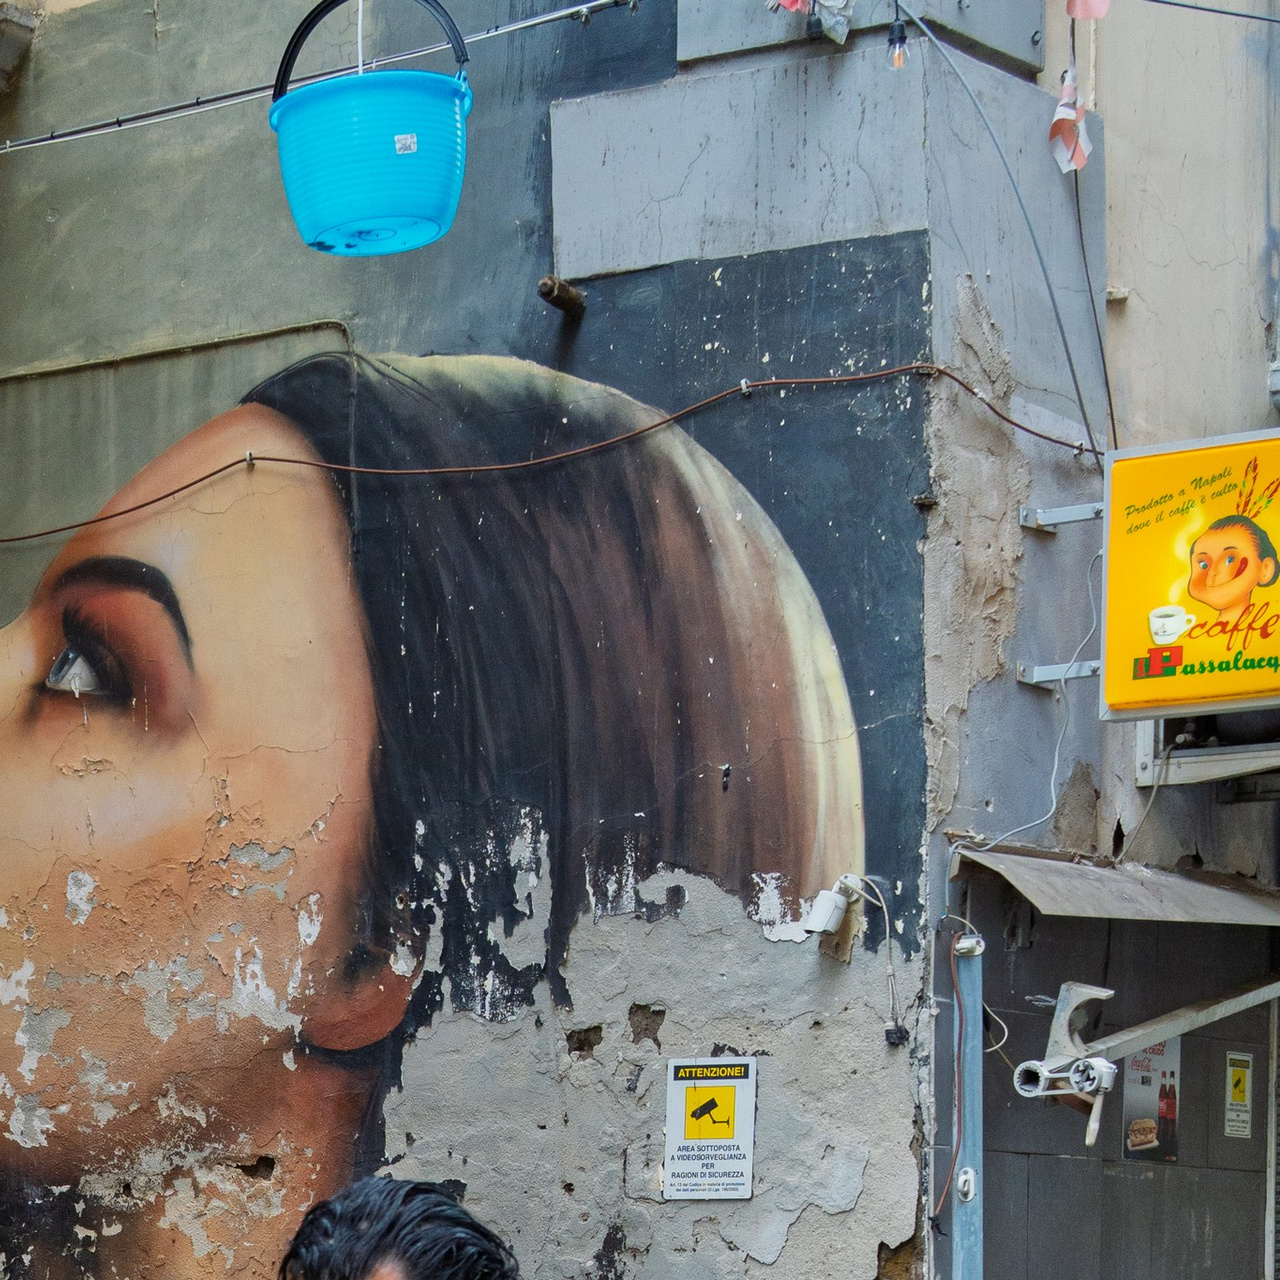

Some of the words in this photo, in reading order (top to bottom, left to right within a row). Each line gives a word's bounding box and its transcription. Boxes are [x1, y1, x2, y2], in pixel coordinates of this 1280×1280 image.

[1124, 492, 1175, 519] Prodotto
[1178, 488, 1186, 497] a
[1190, 466, 1233, 491] Napoli
[1126, 519, 1151, 535] dove
[1155, 510, 1164, 523] il
[1210, 482, 1239, 500] culto
[678, 1066, 745, 1078] ATTENZIONE!
[677, 1145, 695, 1153] AREA
[696, 1144, 741, 1152] SOTTOPOSTA
[670, 1154, 675, 1162] A
[676, 1153, 747, 1161] VIDEOSORVEGLIANZA
[701, 1162, 715, 1170] PER
[671, 1171, 699, 1179] RAGIONI
